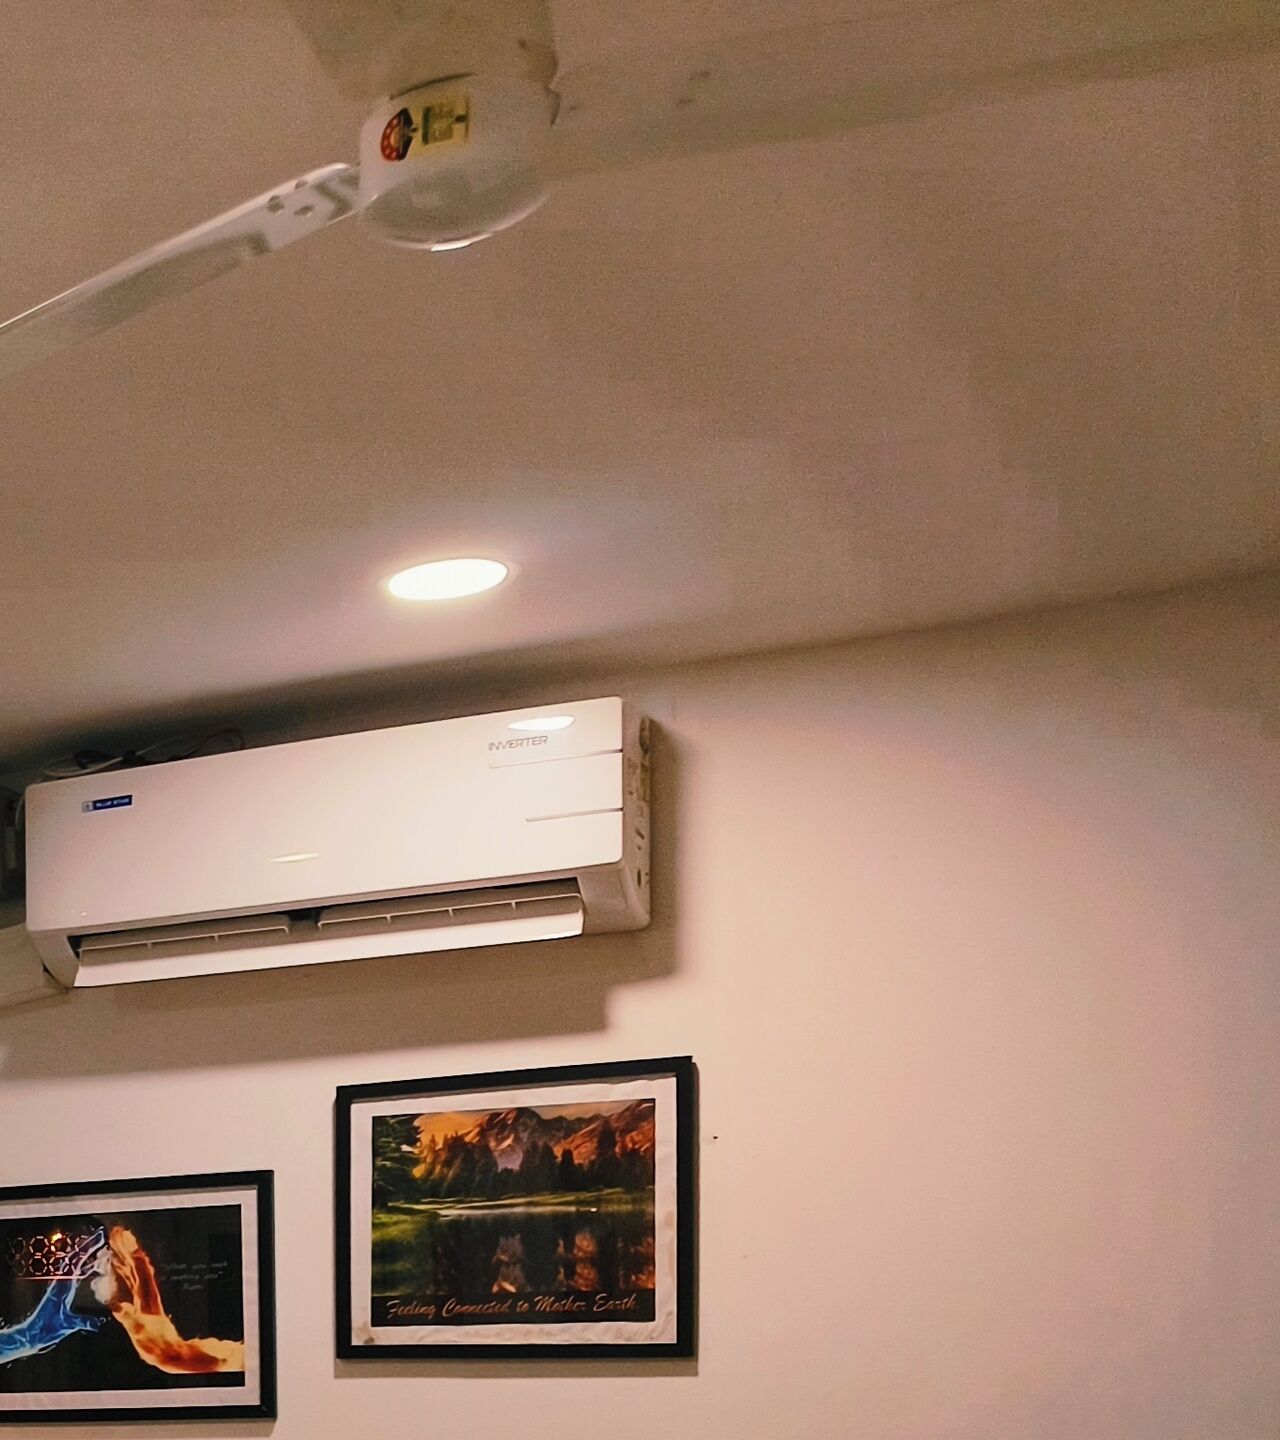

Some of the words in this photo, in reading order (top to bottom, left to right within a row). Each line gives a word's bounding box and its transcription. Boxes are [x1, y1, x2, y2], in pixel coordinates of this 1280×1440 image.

[488, 735, 549, 751] INVERTER
[387, 1301, 436, 1319] Feeling
[443, 1298, 510, 1317] Connected
[517, 1301, 528, 1312] to
[534, 1296, 586, 1312] Mother
